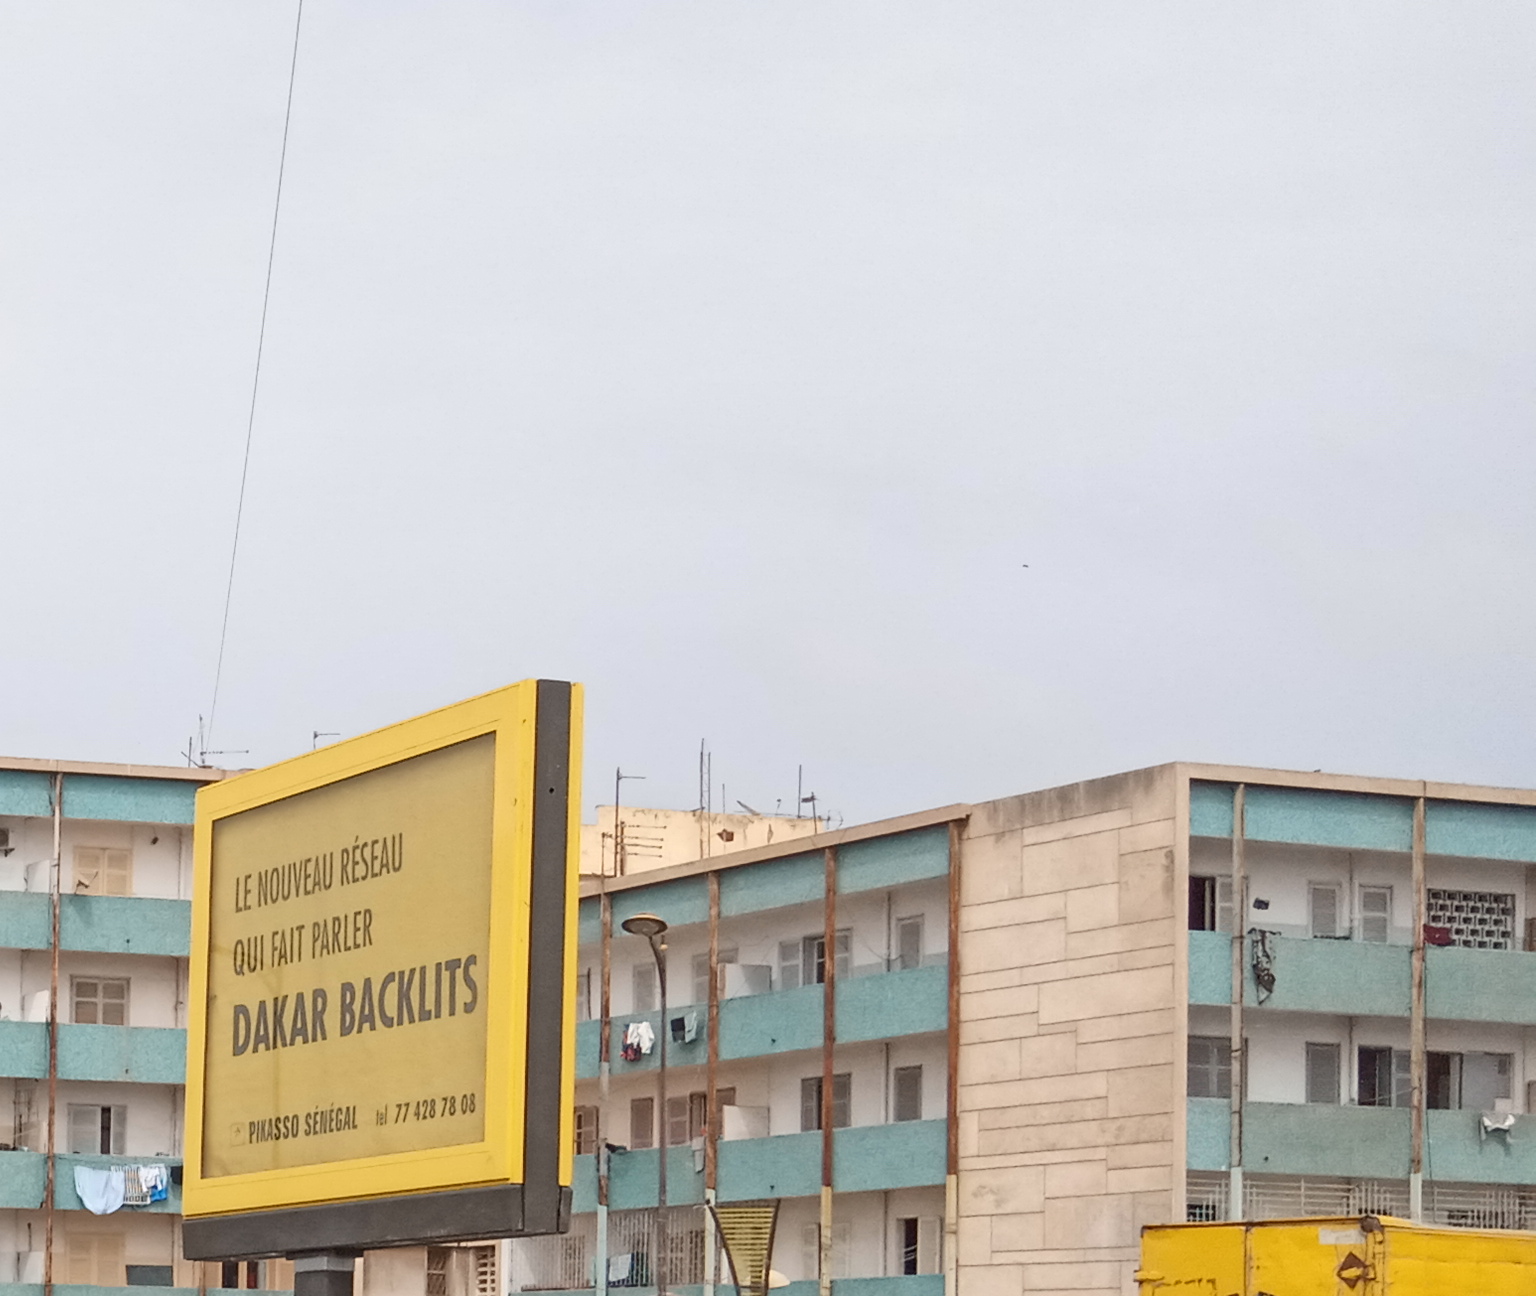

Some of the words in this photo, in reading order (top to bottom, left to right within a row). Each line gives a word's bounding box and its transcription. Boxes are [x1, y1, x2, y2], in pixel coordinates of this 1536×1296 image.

[235, 874, 252, 913] LE
[258, 852, 333, 907] NOUVEAU
[340, 832, 403, 886] RÉSEAU
[233, 935, 264, 976] QUI
[271, 924, 305, 968] FAIT
[312, 908, 373, 959] PARLER
[232, 988, 327, 1056] DAKAR
[340, 954, 478, 1037] BACKLITS
[248, 1114, 299, 1144] PIKASSO
[304, 1102, 358, 1137] SÉNÉGAL
[376, 1103, 388, 1126] tel
[394, 1102, 410, 1124] 77
[413, 1099, 436, 1121] 428
[440, 1096, 457, 1117] 78
[461, 1092, 476, 1114] 08
